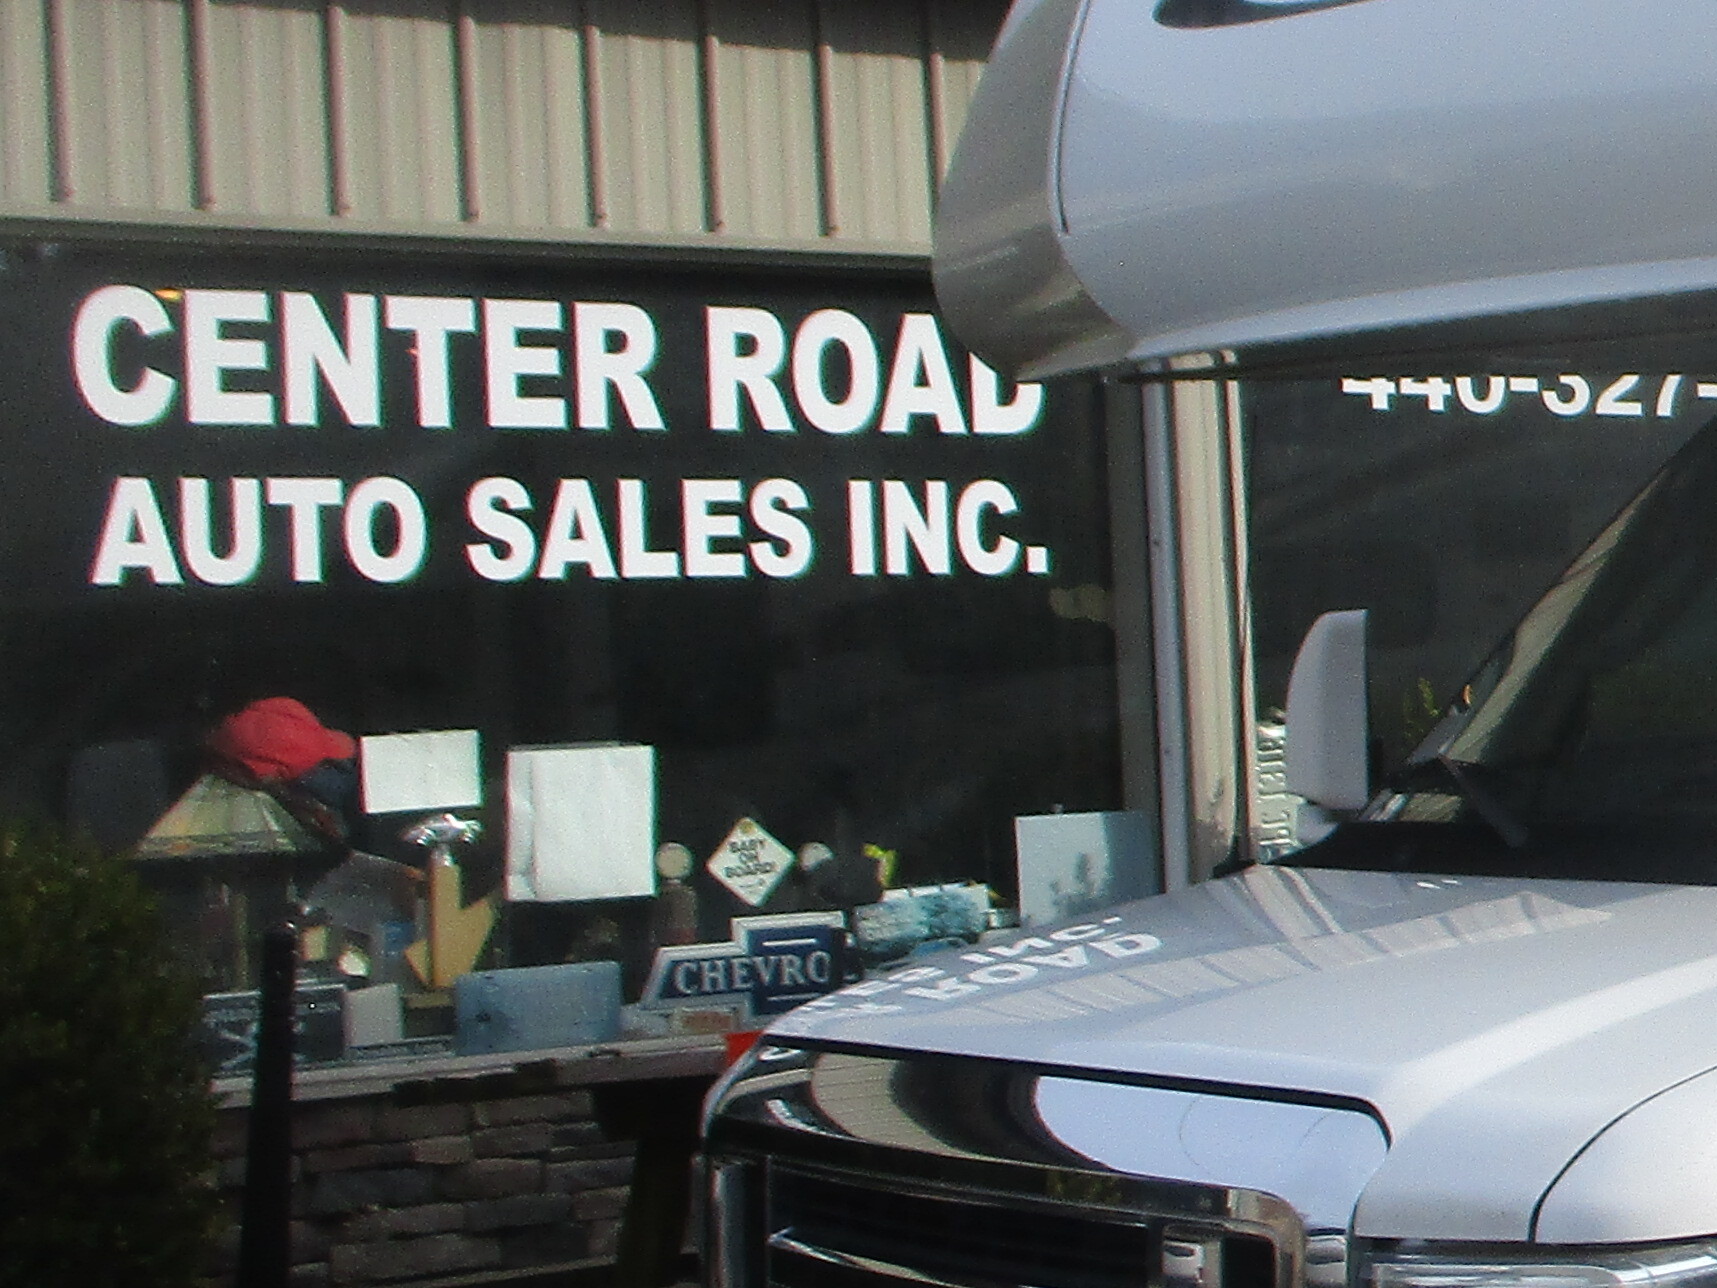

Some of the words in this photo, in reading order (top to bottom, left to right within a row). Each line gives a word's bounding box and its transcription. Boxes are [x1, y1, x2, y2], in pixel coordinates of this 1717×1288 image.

[72, 285, 664, 430] CENTER
[707, 306, 1043, 435] ROAD
[92, 477, 426, 586] AUTO
[466, 477, 813, 581] SALES
[848, 480, 1049, 576] INC.
[729, 838, 766, 852] BABY
[674, 950, 832, 995] CHEVRO
